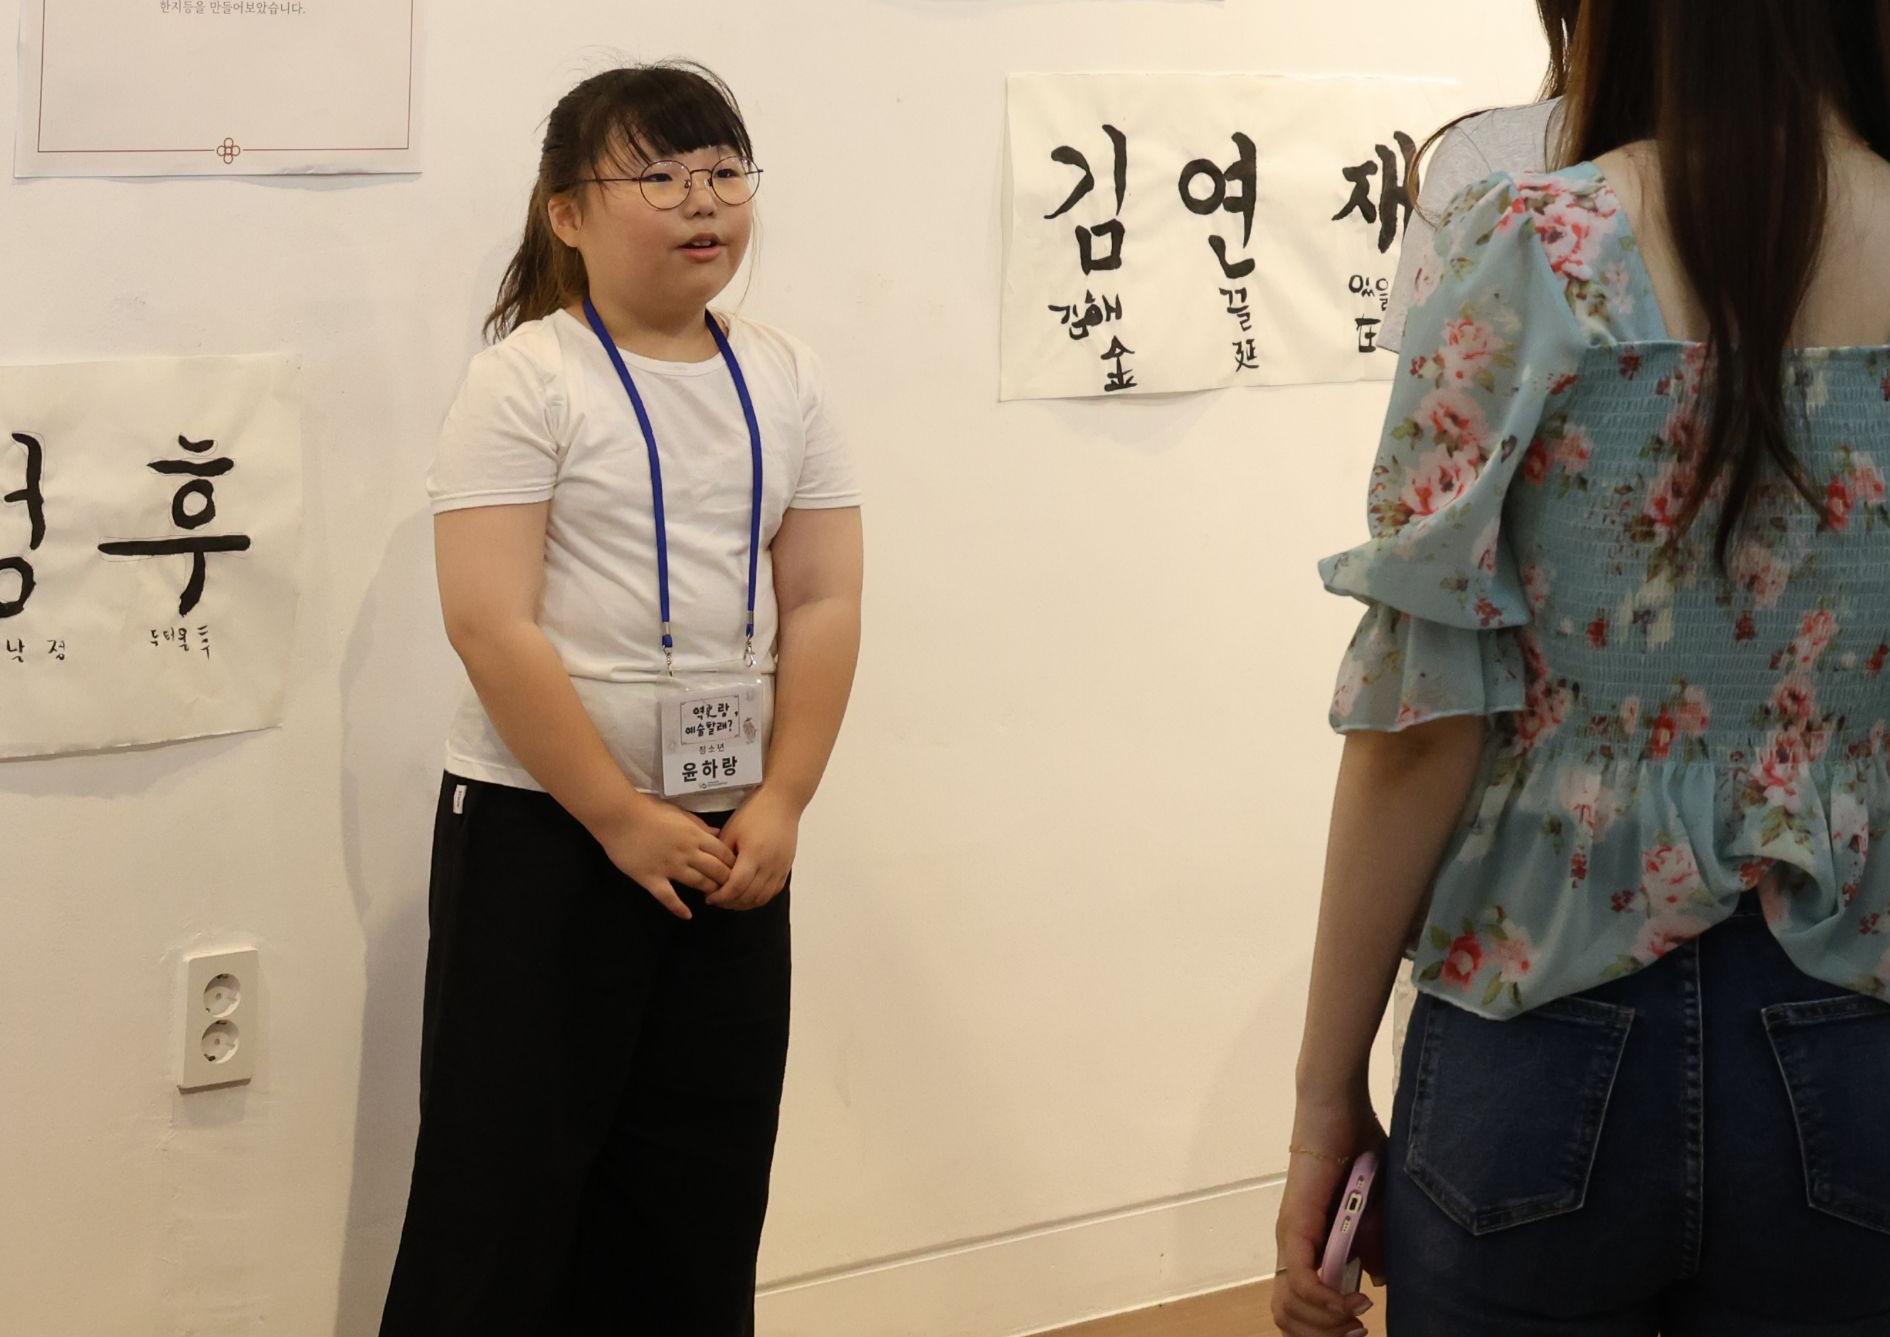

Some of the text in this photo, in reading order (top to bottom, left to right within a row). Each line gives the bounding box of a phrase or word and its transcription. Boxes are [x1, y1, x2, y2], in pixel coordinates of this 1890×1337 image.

[160, 0, 306, 16] 한지등을 만들어보았습니다.
[682, 756, 738, 783] 윤하랑
